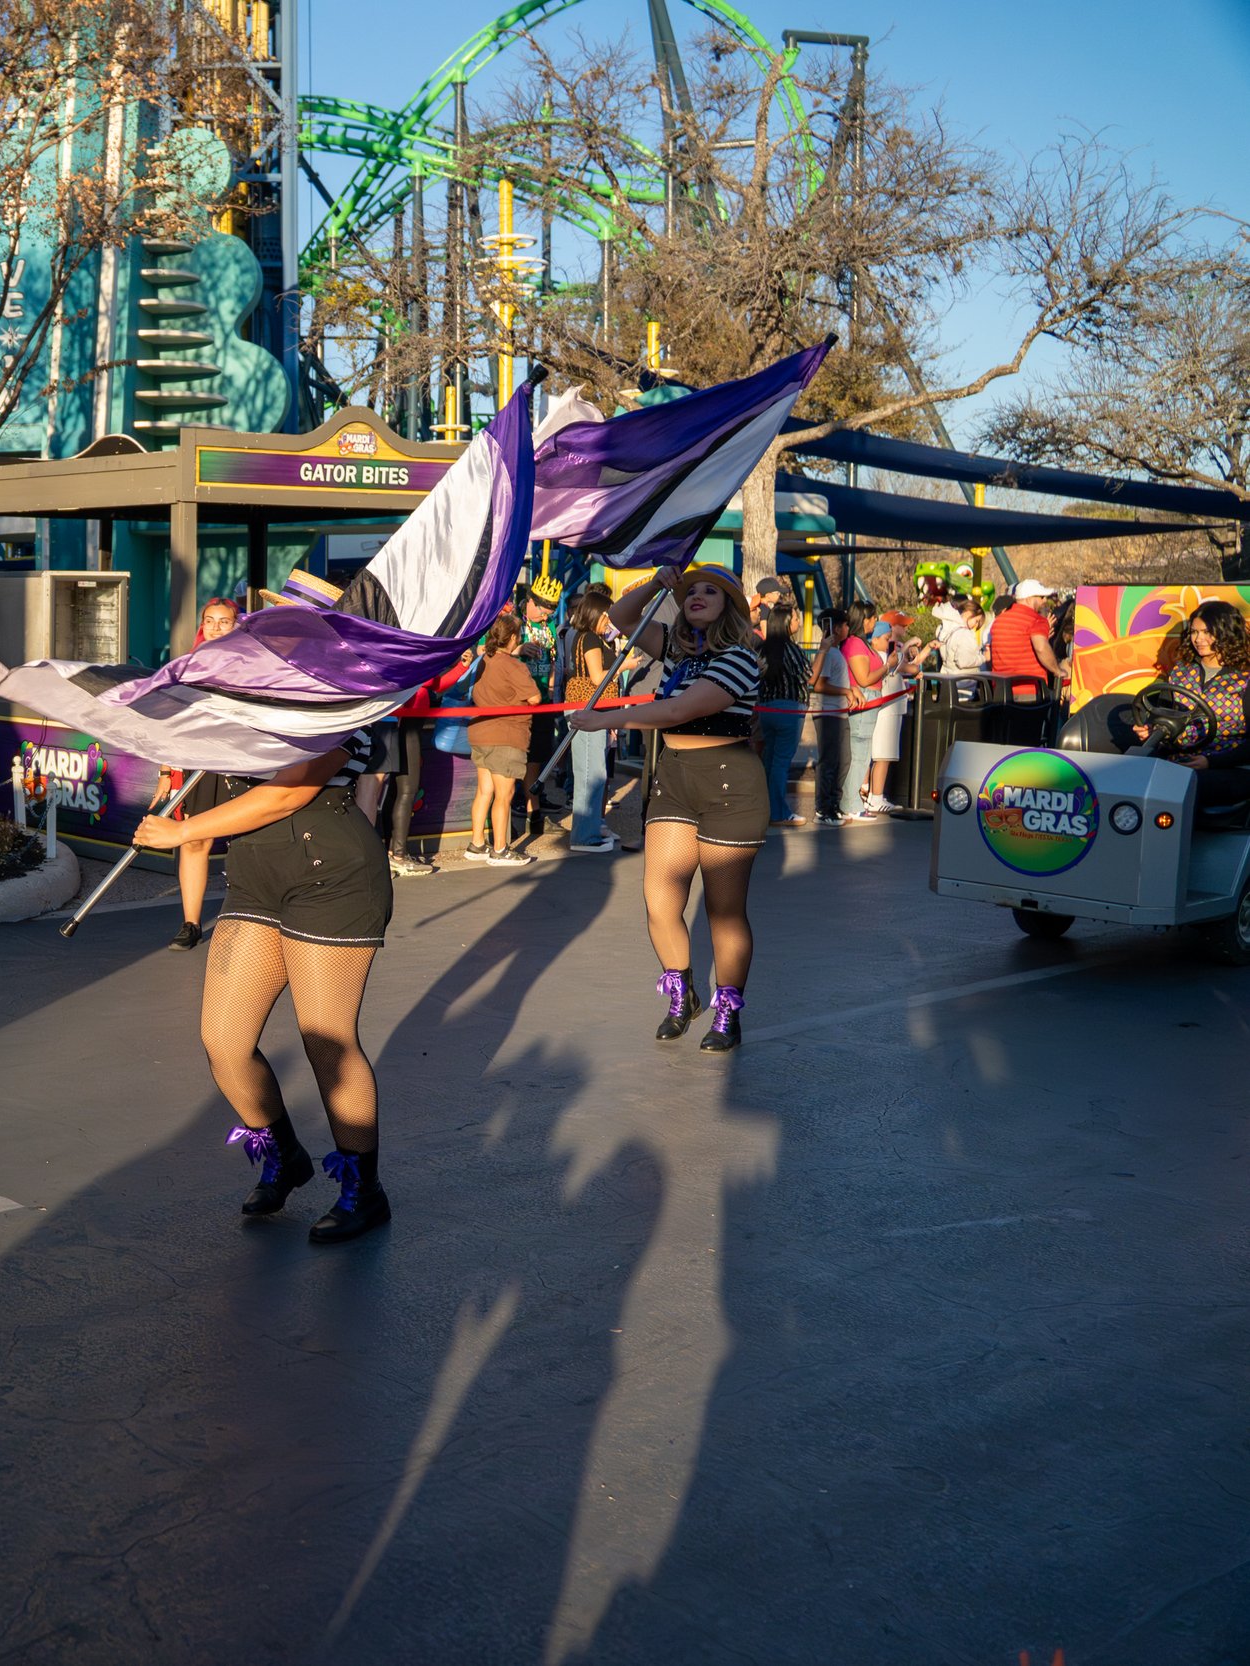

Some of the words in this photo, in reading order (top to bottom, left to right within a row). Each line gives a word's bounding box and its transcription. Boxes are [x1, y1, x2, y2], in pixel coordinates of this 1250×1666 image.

[346, 433, 370, 444] MARDI
[353, 443, 375, 453] GRAS
[300, 462, 357, 483] GATOR
[362, 466, 409, 485] BITES
[31, 747, 89, 781] MARDI
[1003, 786, 1074, 813] MARDI
[1023, 810, 1088, 836] GRAS
